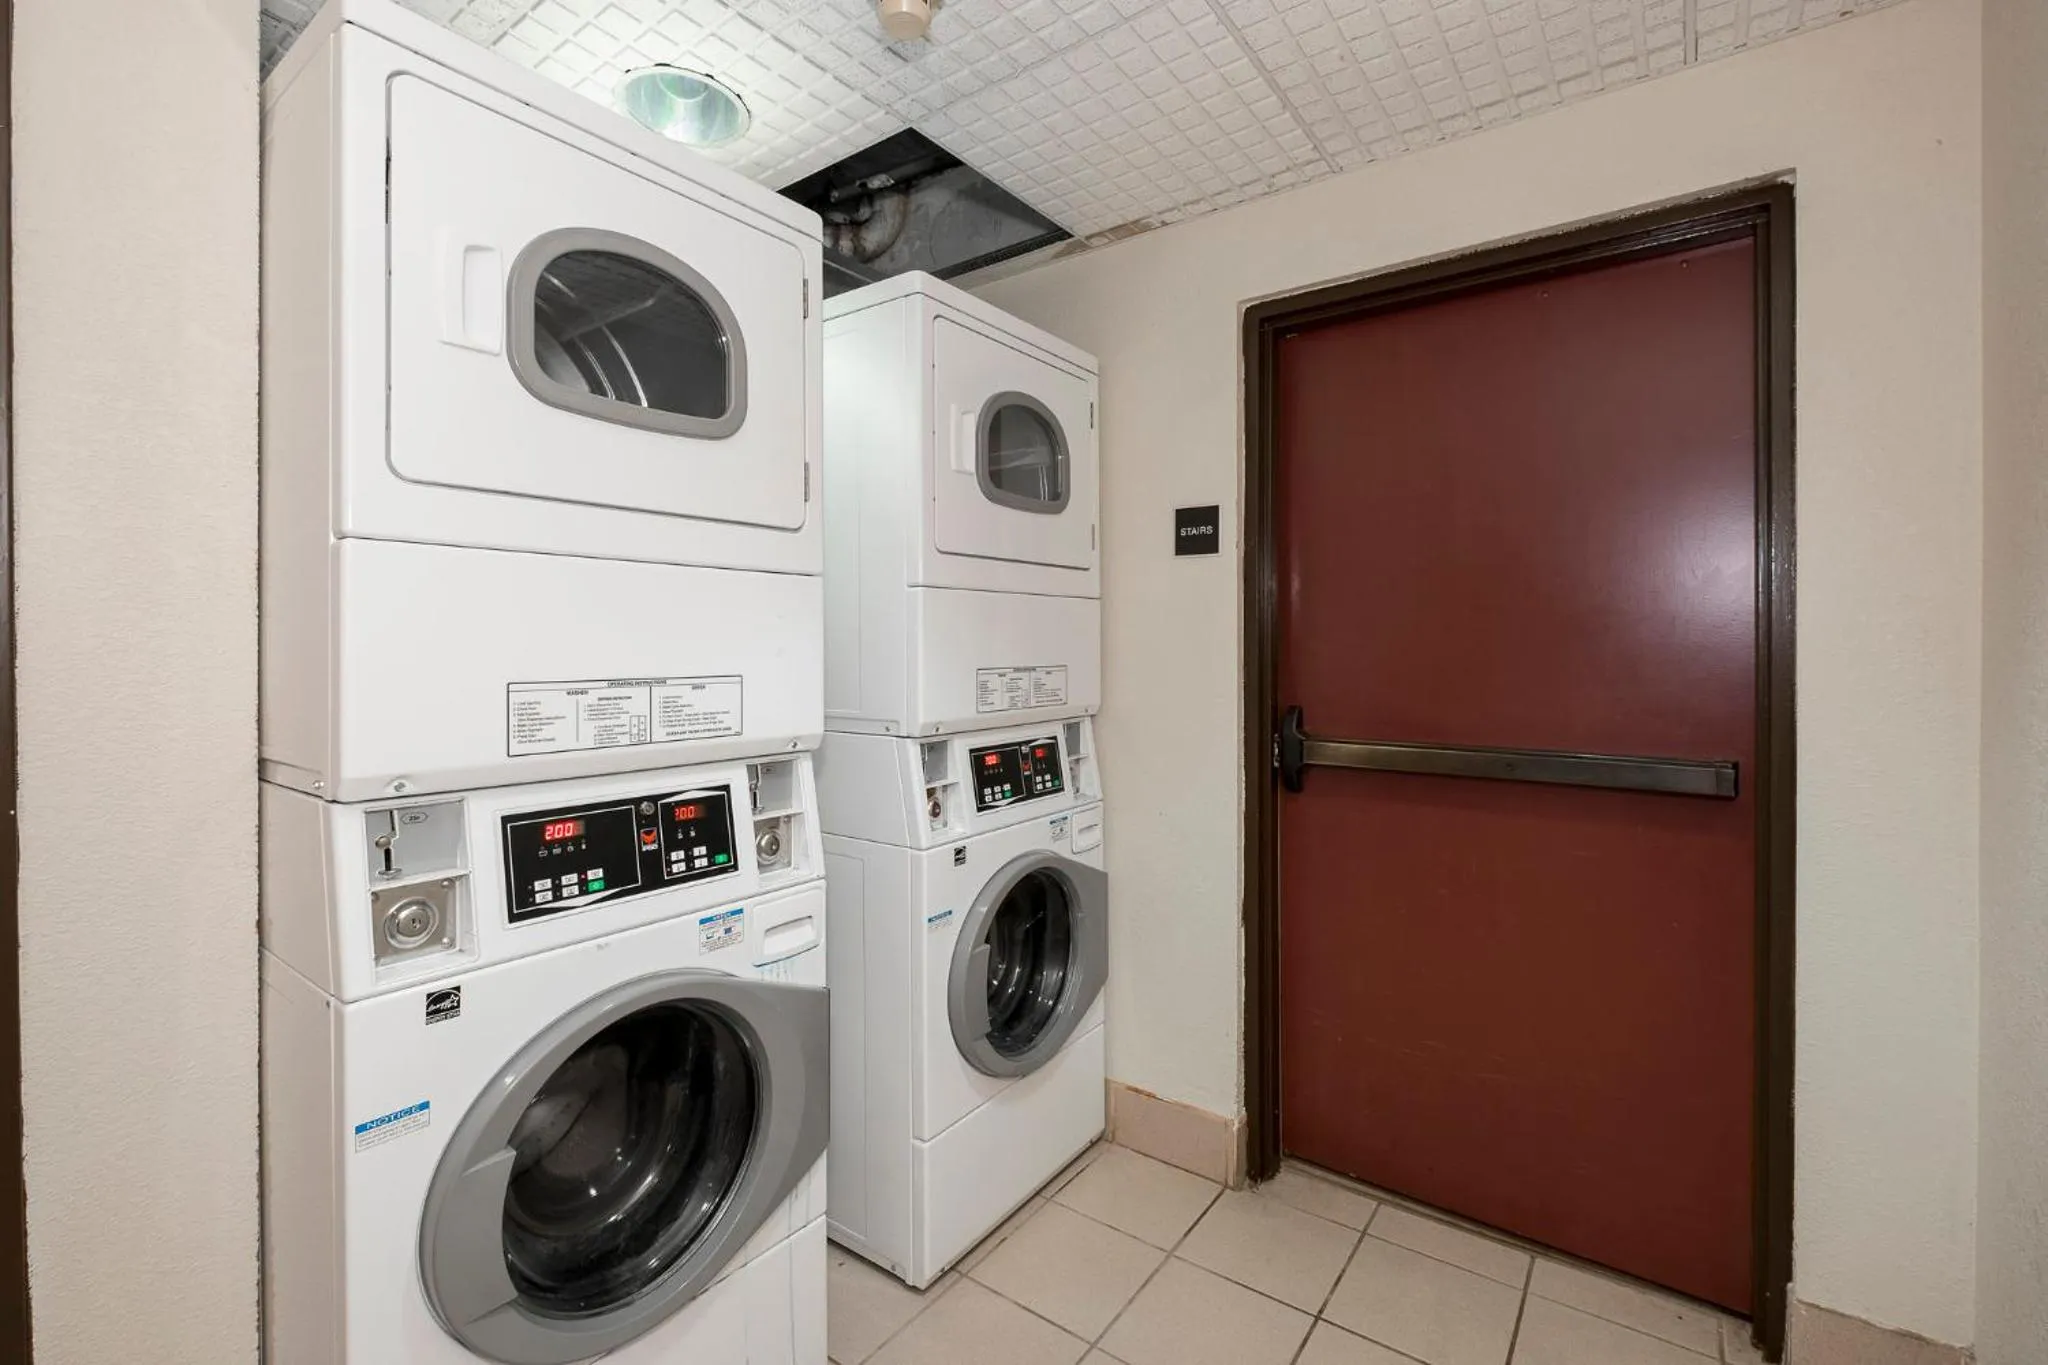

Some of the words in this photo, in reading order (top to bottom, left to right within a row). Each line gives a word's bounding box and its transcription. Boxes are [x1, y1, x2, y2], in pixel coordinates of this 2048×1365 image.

[1180, 525, 1213, 536] STAIRS
[545, 822, 573, 840] 200
[366, 1106, 420, 1129] NOTICE
